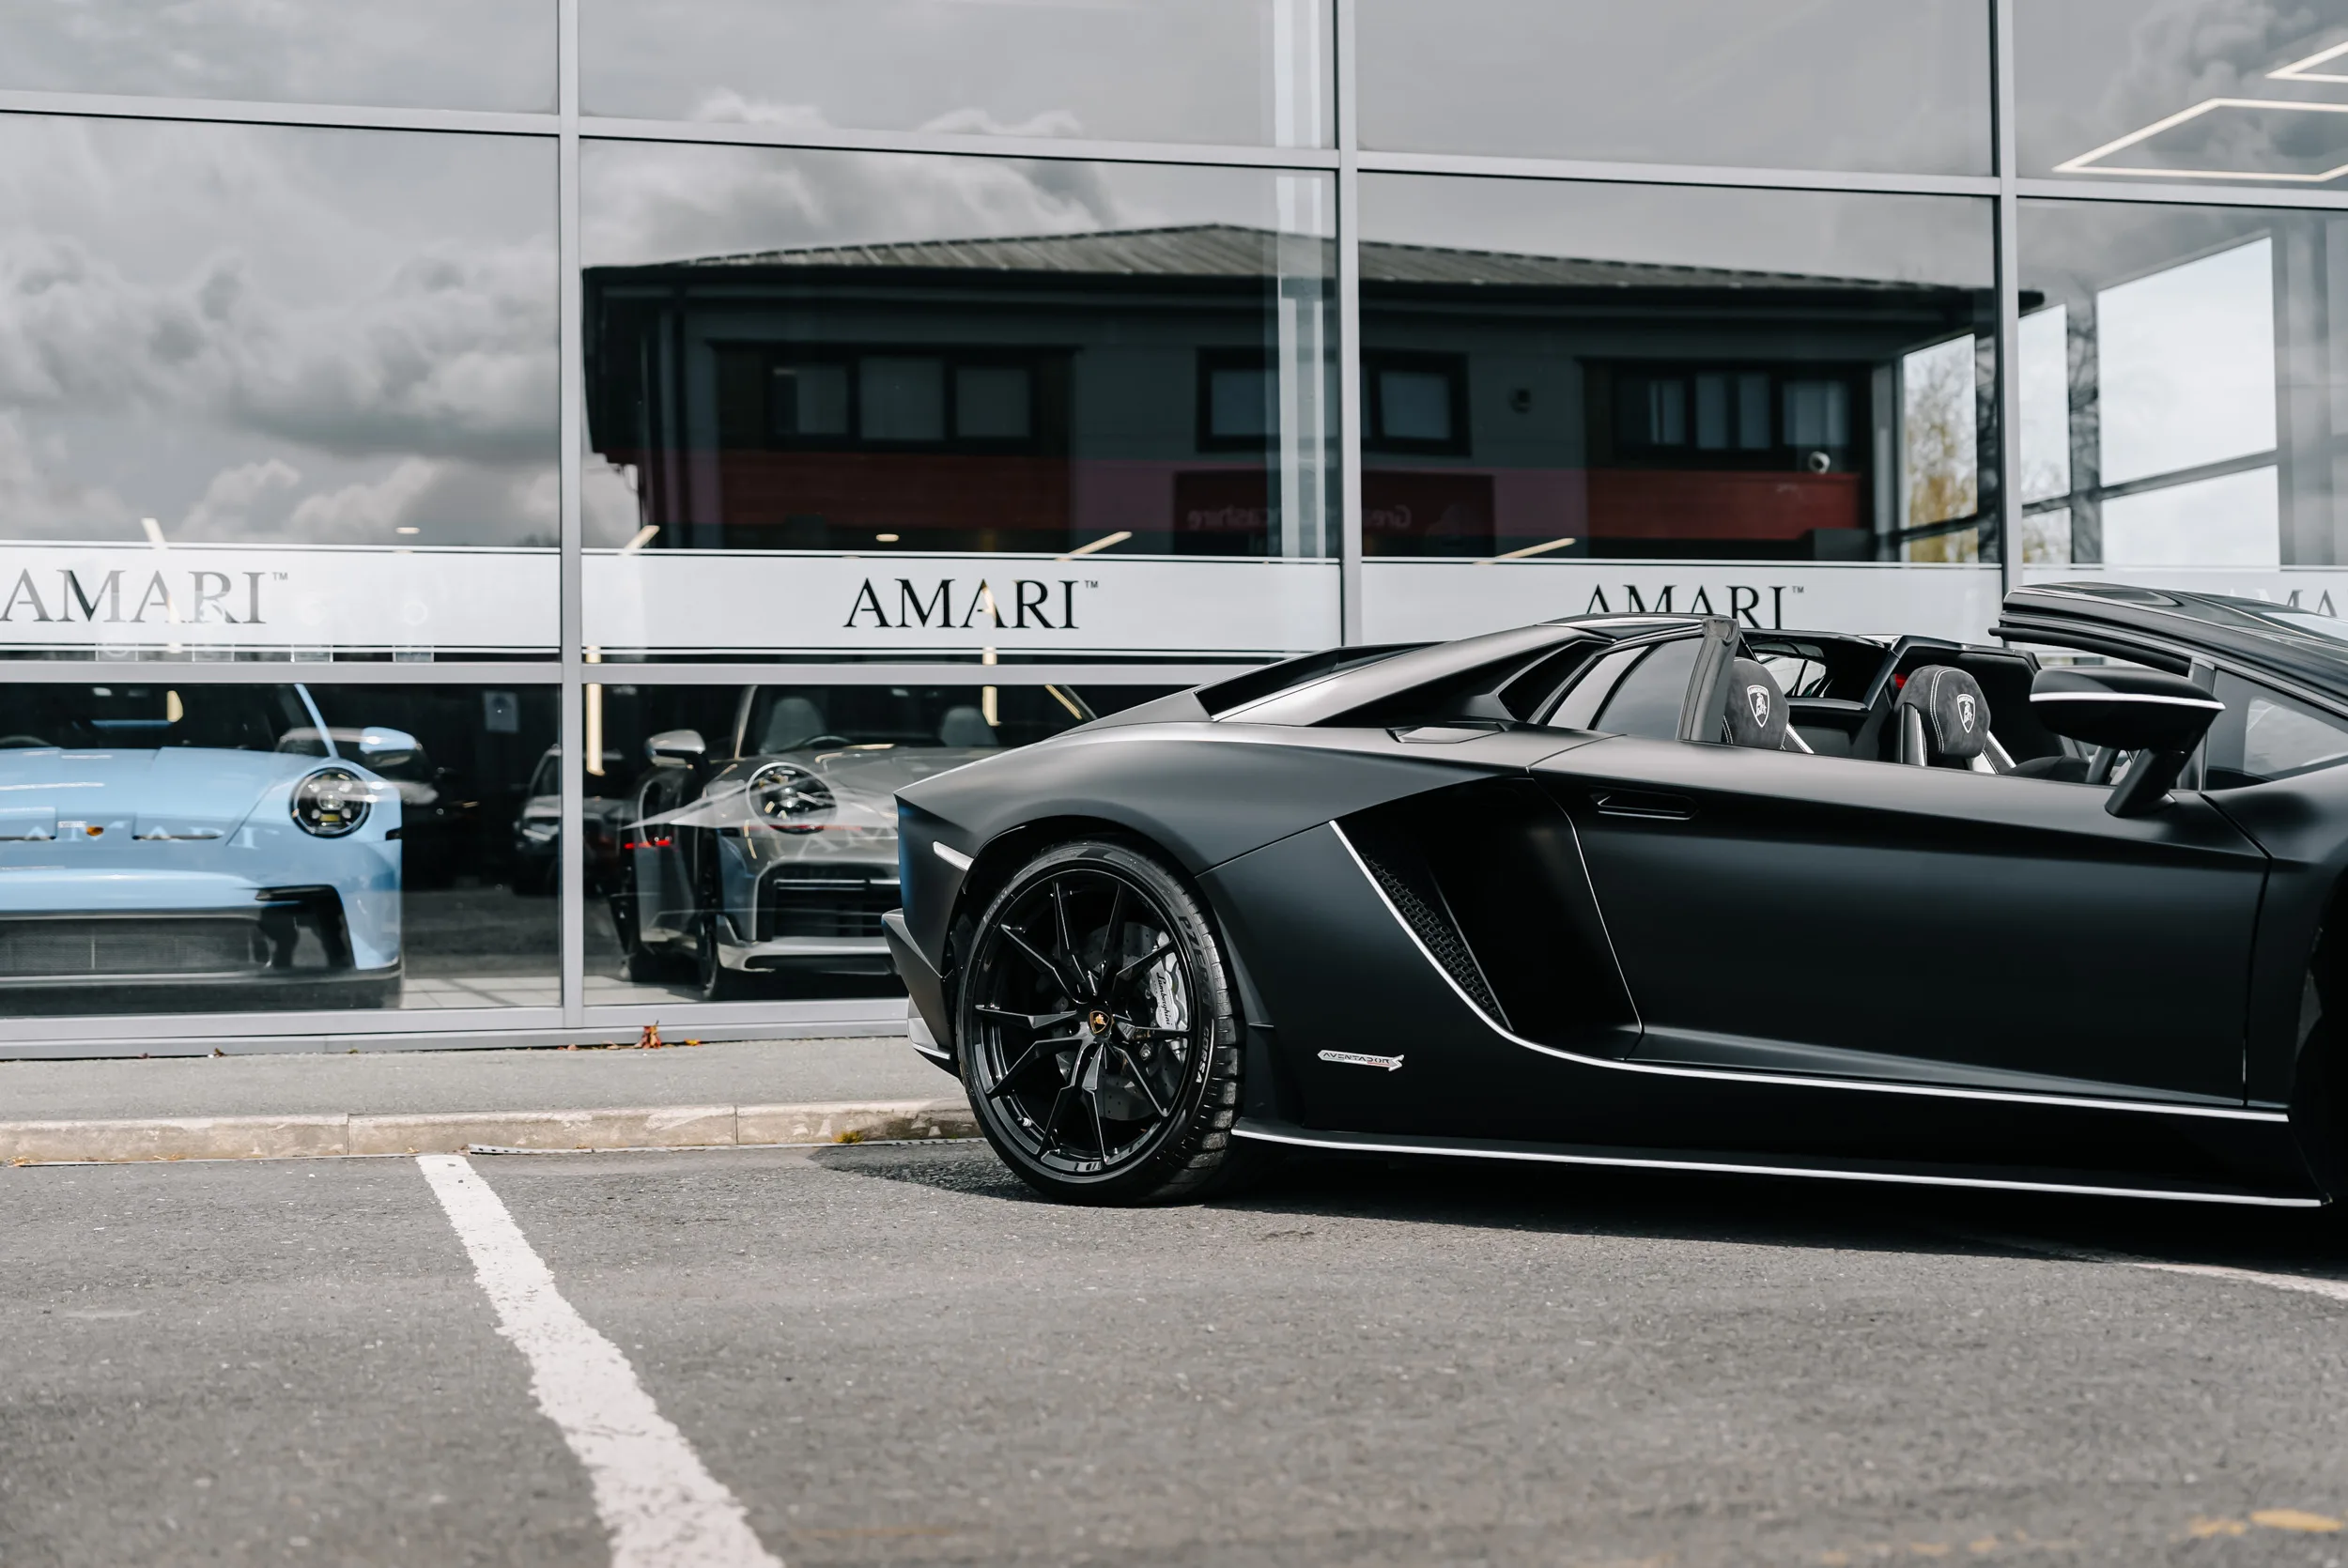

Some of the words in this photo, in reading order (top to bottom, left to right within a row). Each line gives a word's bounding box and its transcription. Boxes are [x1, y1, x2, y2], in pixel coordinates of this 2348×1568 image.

[0, 567, 267, 624] AMARI
[842, 577, 1079, 629] AMARI
[1586, 584, 1786, 630] AMARI
[1196, 1025, 1210, 1084] CORSA
[1323, 1052, 1390, 1065] AVENTADOR
